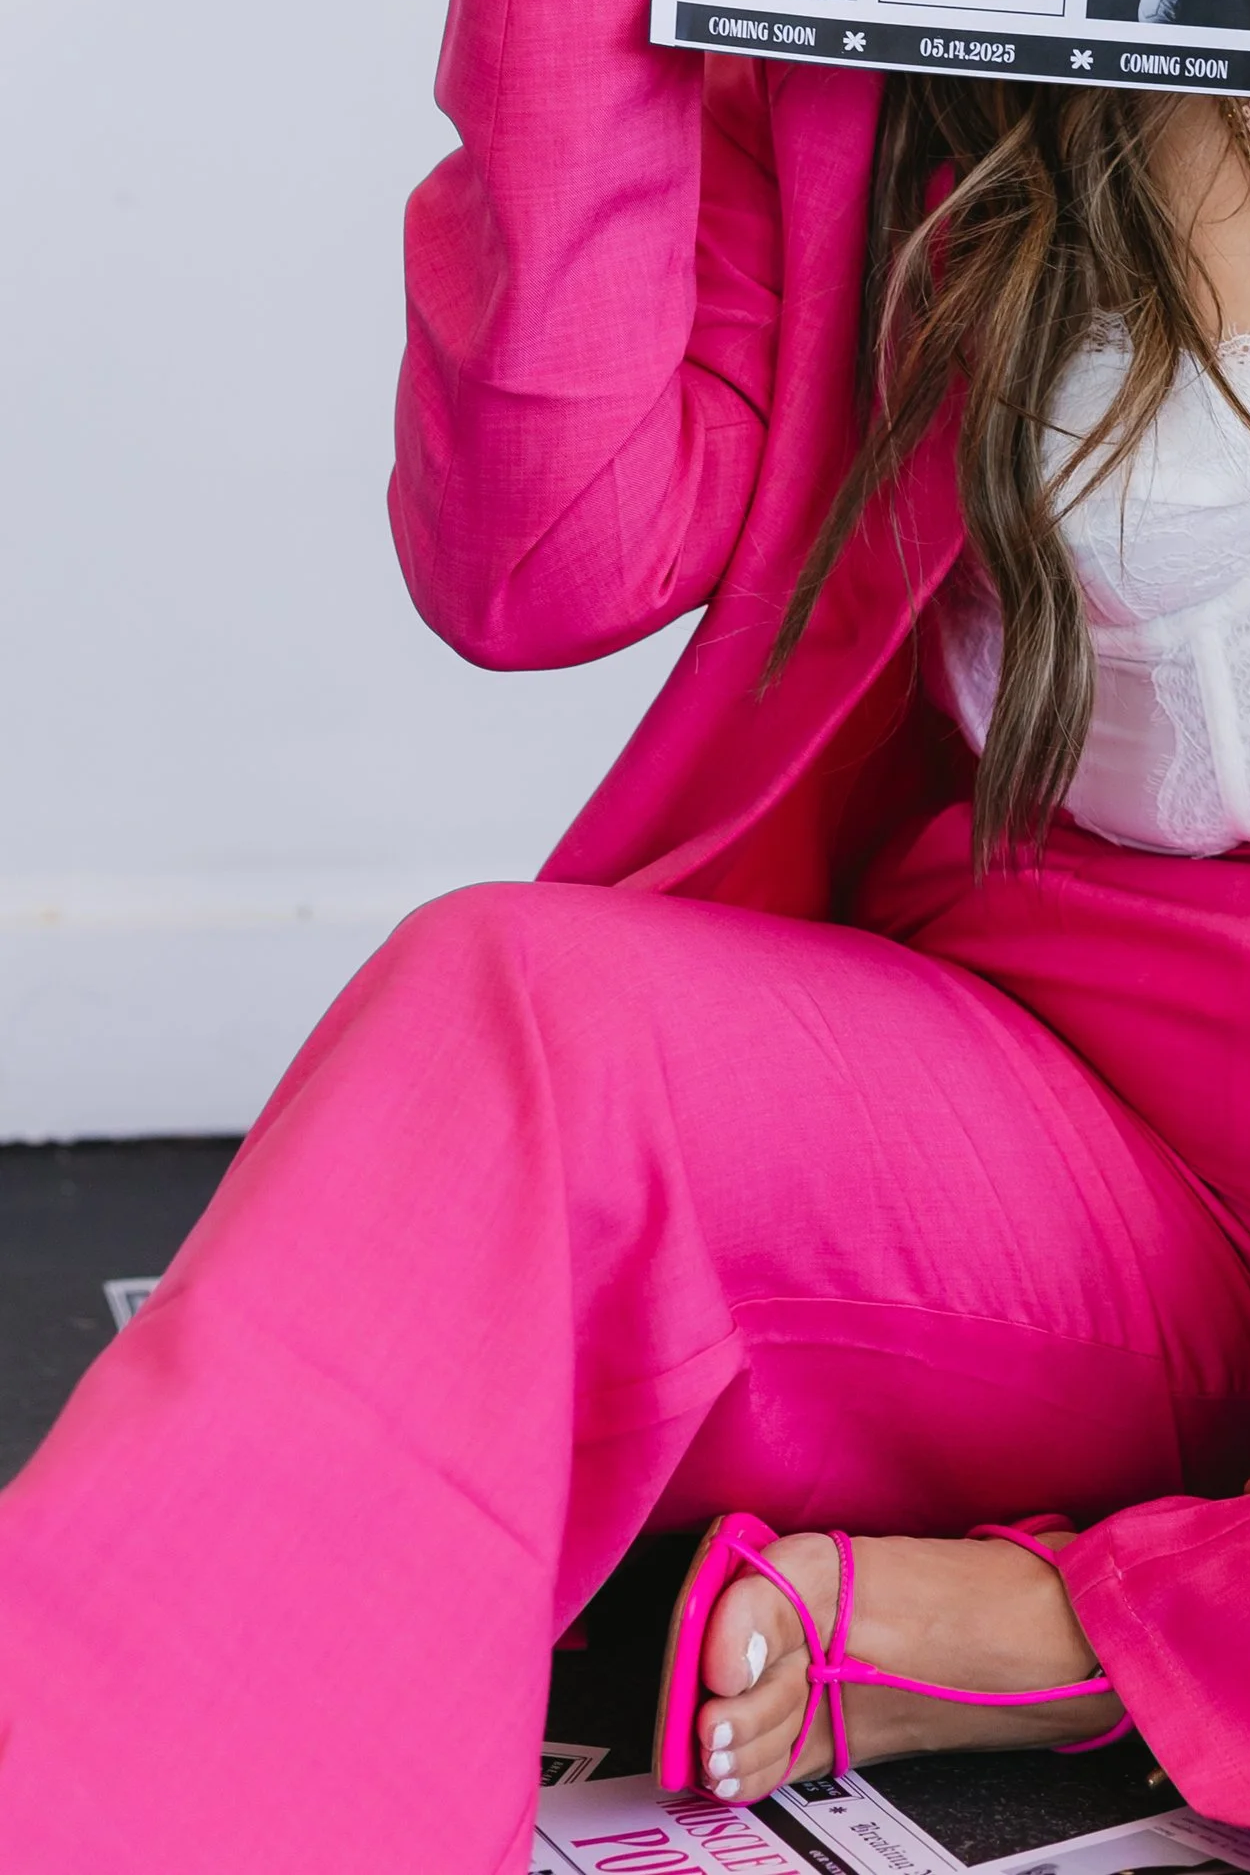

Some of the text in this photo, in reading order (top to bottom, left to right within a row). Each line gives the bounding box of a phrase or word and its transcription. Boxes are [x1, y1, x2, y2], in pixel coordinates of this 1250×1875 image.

[708, 16, 816, 47] COMING SOON
[920, 38, 1016, 63] 05.14.2025
[1120, 53, 1228, 79] COMING SOON
